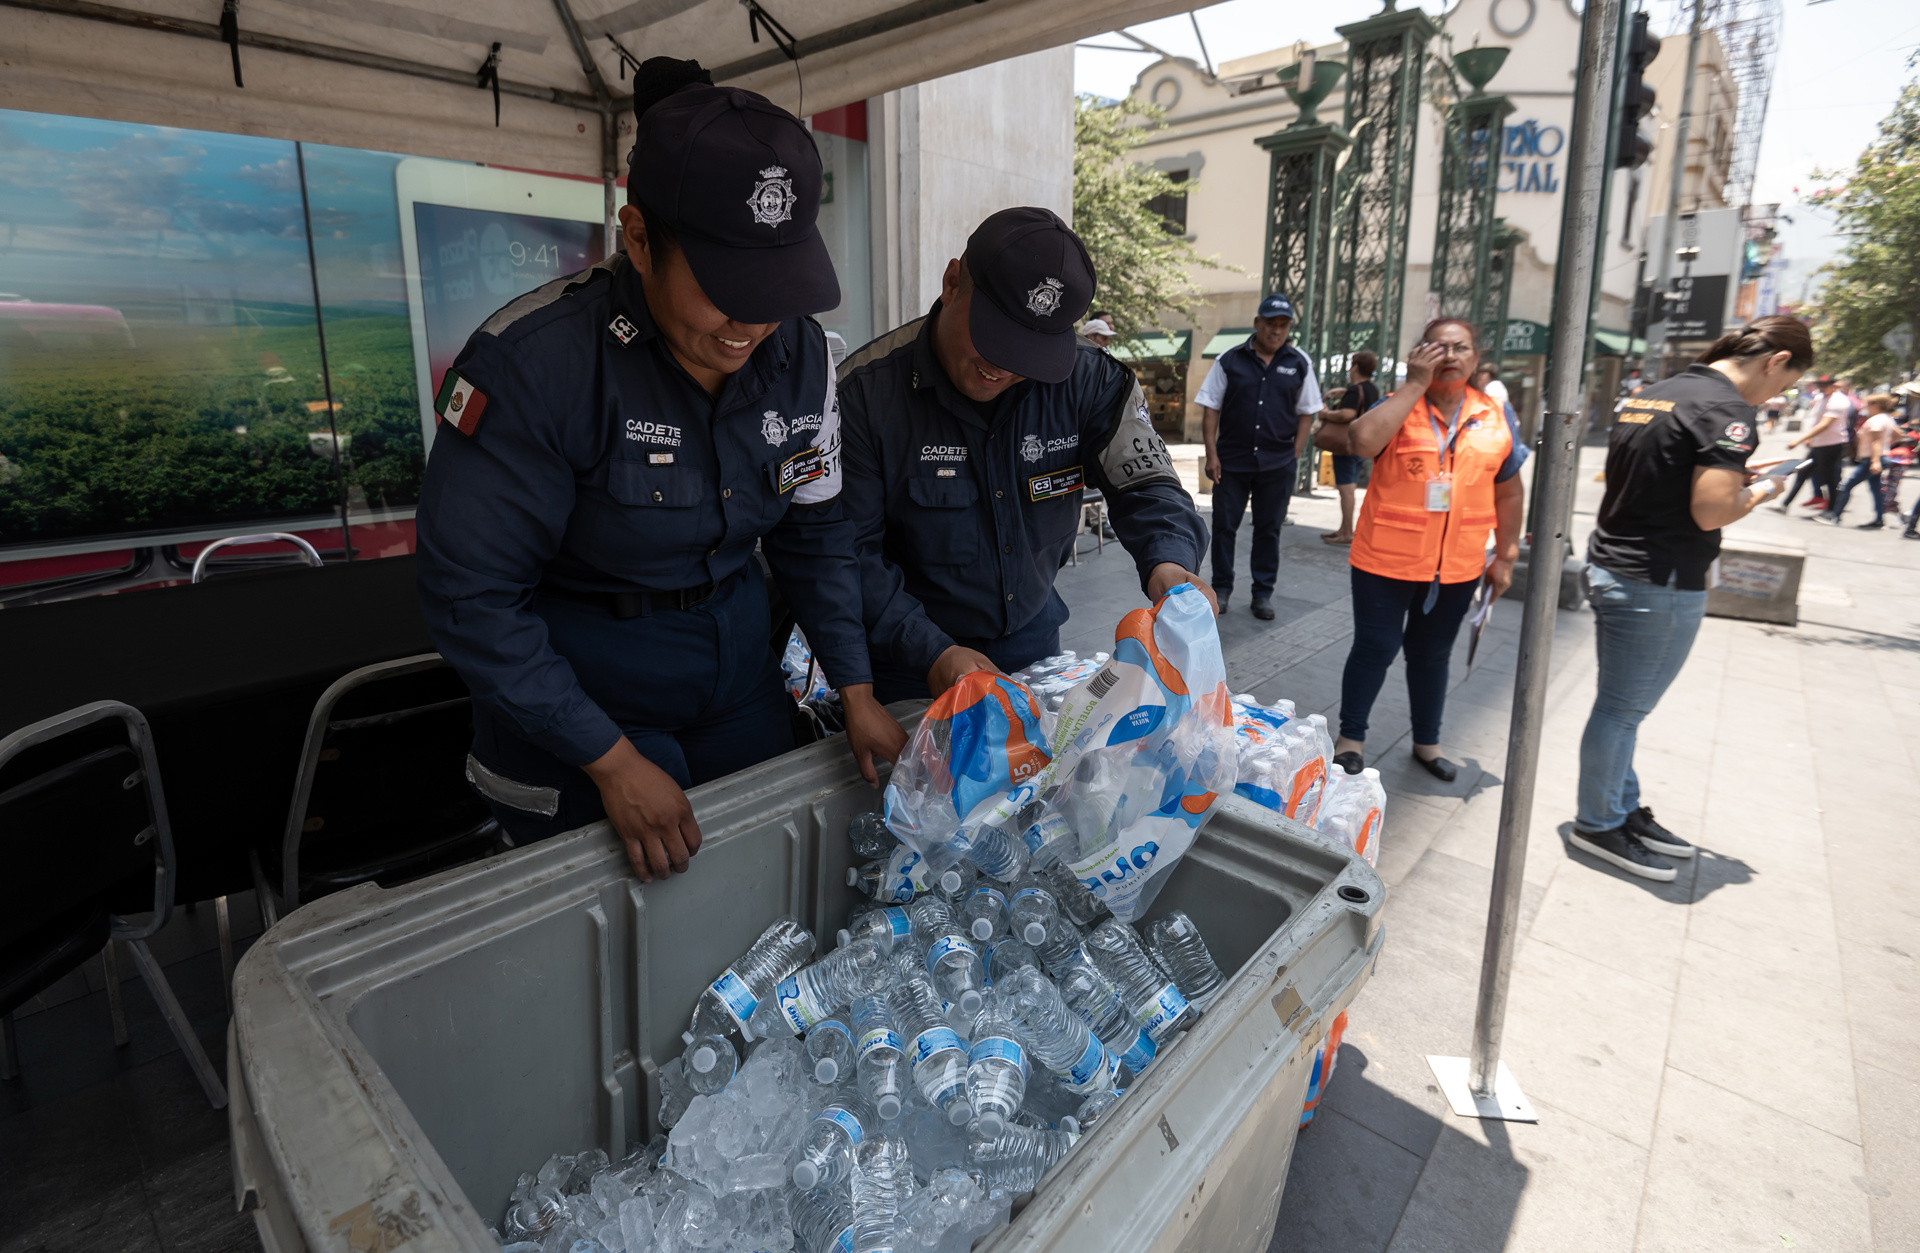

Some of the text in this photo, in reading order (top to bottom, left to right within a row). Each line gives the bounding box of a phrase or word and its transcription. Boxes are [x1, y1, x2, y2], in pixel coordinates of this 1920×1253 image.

[509, 241, 560, 269] 9:41
[614, 318, 637, 339] C3
[626, 419, 681, 438] CADETE
[626, 431, 681, 447] MONTERREY
[1133, 438, 1167, 453] CAD
[922, 445, 968, 455] CADETE
[656, 454, 667, 463] C3
[1034, 480, 1049, 491] C3
[1072, 700, 1098, 733] BOTELLA
[1129, 711, 1149, 720] IMAGEN
[1132, 718, 1150, 726] NUEVA
[1074, 859, 1105, 874] Member's
